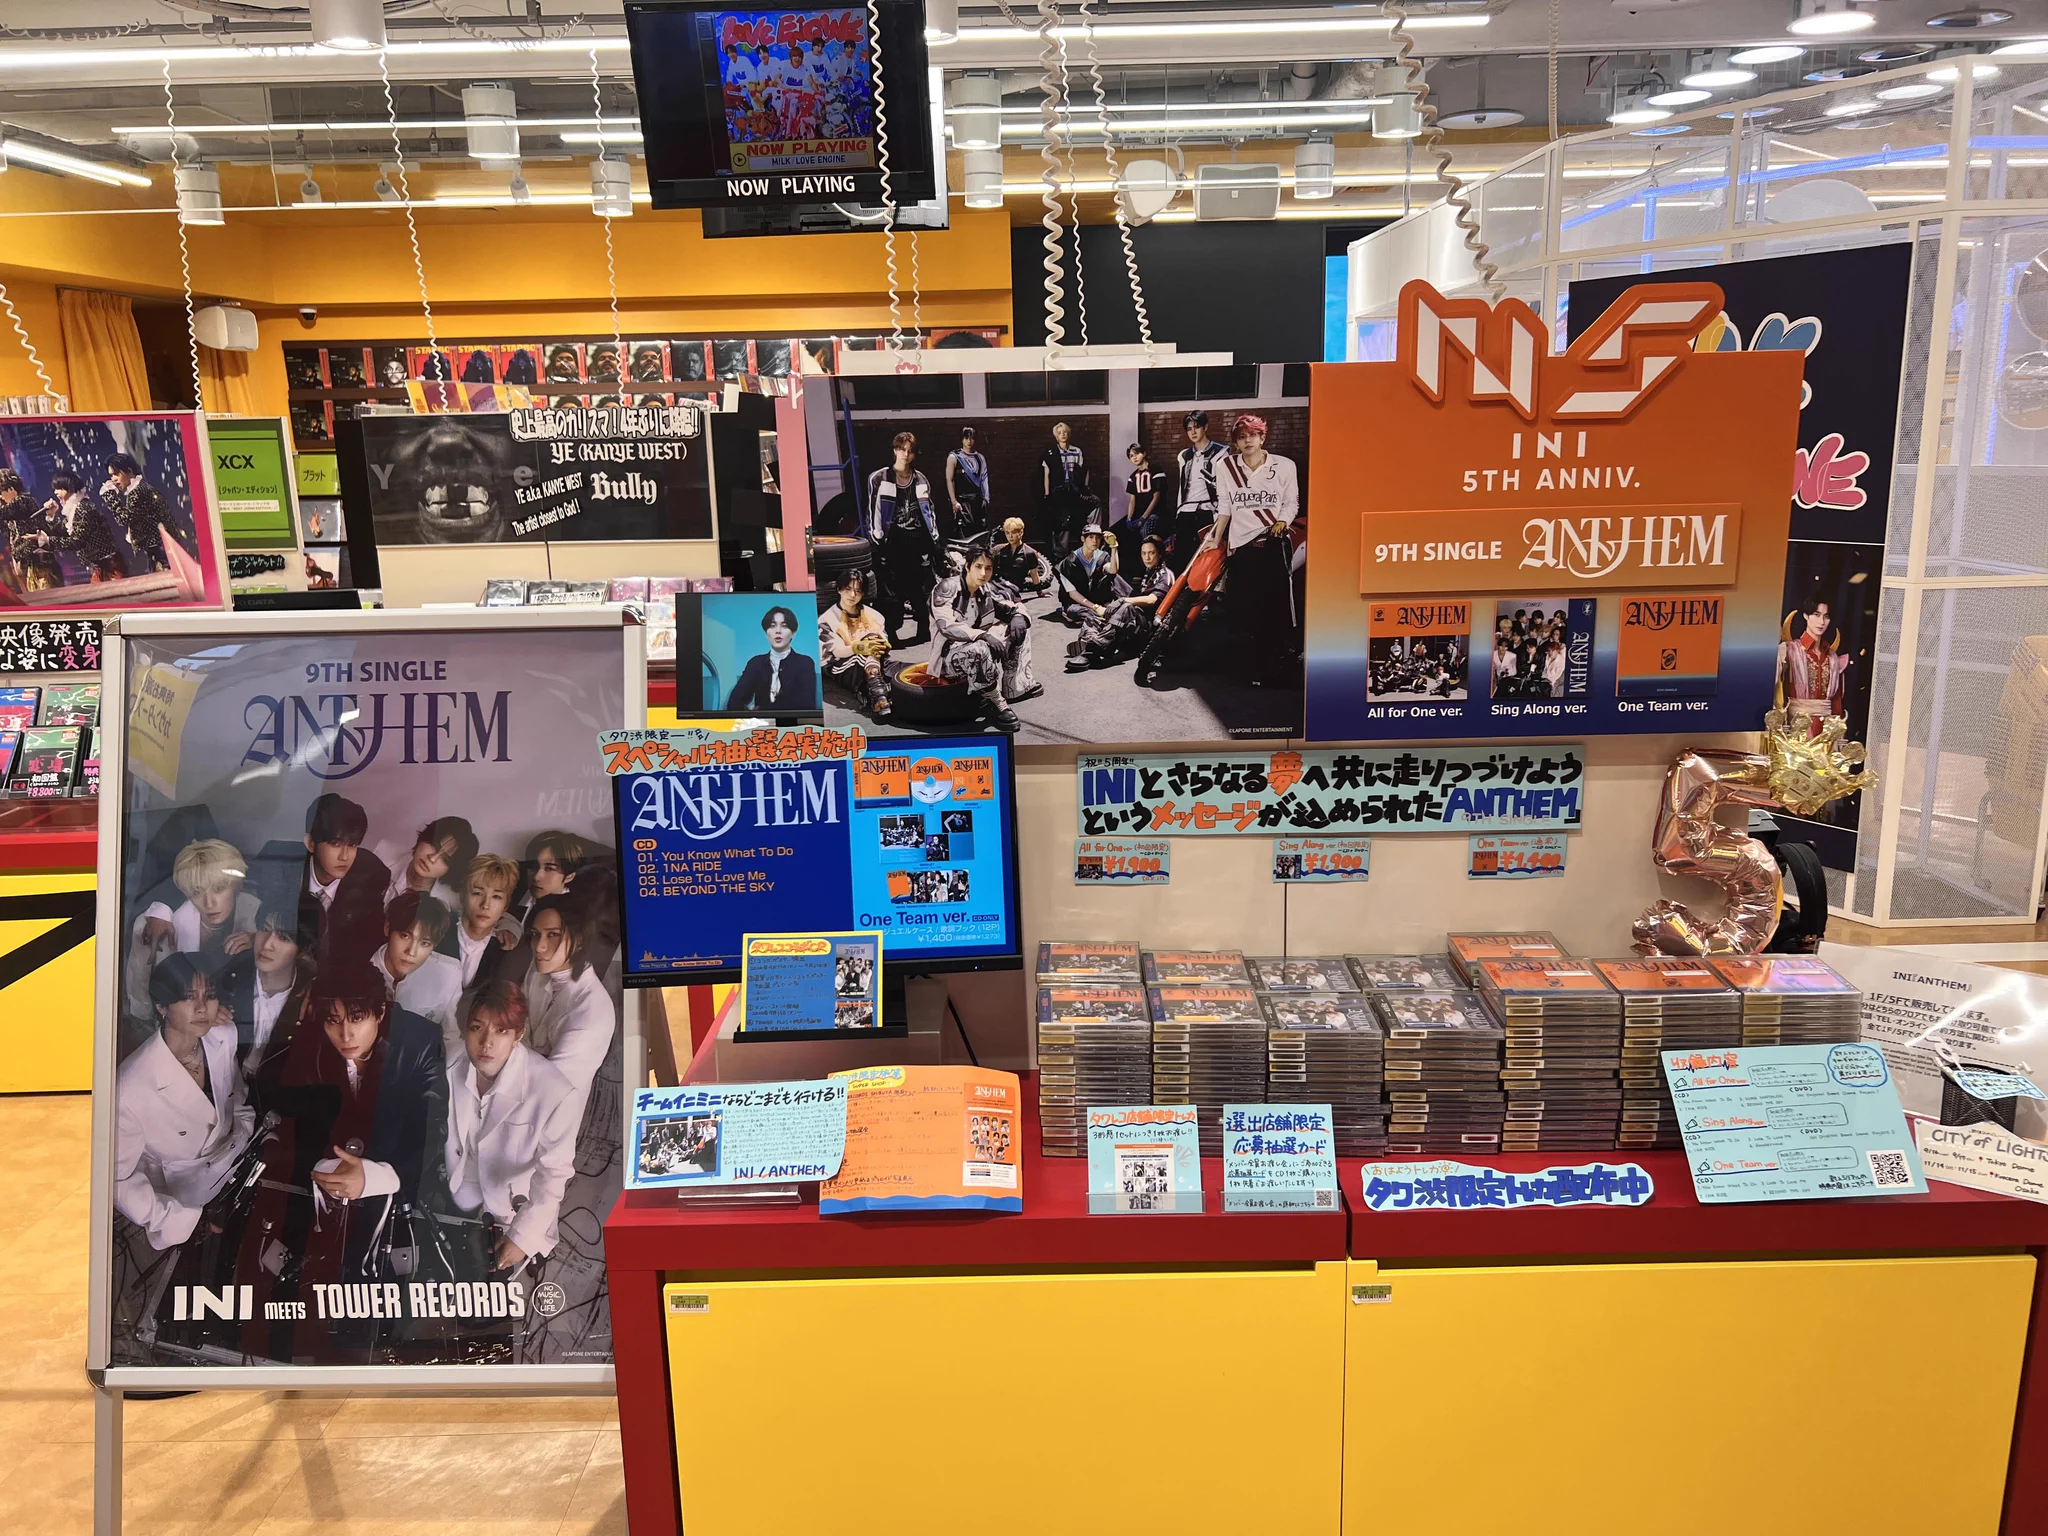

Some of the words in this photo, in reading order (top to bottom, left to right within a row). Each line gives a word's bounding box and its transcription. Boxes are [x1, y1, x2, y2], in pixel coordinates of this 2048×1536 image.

[746, 143, 785, 156] NOW
[792, 140, 867, 154] PLAYING
[795, 156, 815, 165] LOVE
[817, 155, 846, 164] ENGINE
[727, 178, 769, 197] NOW
[781, 175, 856, 195] PLAYING
[551, 442, 576, 465] YE
[578, 443, 637, 463] (KANYE
[638, 441, 688, 461] WEST)
[1512, 431, 1587, 459] INI
[218, 455, 255, 469] XCX
[370, 464, 395, 490] Y
[513, 465, 534, 487] e
[542, 476, 566, 497] KANYE
[565, 472, 584, 491] WEST
[1135, 472, 1151, 493] 10
[1463, 468, 1521, 492] 5TH
[1535, 465, 1640, 491] ANNIV.
[590, 471, 658, 504] Bully
[512, 519, 525, 536] The
[525, 514, 539, 532] artist
[538, 506, 558, 528] closest
[564, 500, 576, 518] God
[1374, 542, 1418, 562] 9TH
[1422, 540, 1503, 561] SINGLE
[1518, 514, 1728, 579] ANTHEM
[1396, 604, 1467, 629] ANTHEM
[1624, 600, 1719, 631] ANTHEM
[1568, 631, 1591, 693] ANTHEM
[305, 662, 353, 683] 9TH
[360, 660, 447, 682] SINGLE
[1367, 706, 1385, 718] All
[1387, 705, 1408, 718] for
[1410, 706, 1437, 718] One
[1438, 707, 1463, 717] ver.
[1490, 704, 1523, 719] Sing
[1526, 703, 1560, 718] Along
[1564, 705, 1587, 715] ver.
[1618, 701, 1644, 713] One
[1647, 701, 1683, 713] Team
[1687, 701, 1709, 711] ver.
[240, 690, 513, 780] ANTHEM
[603, 727, 867, 774] スペシャル抽選会実施中
[861, 758, 907, 775] ANTHEM
[915, 765, 944, 775] ANTHEM
[954, 759, 989, 776] ANTHEM
[1082, 752, 1583, 806] INIとさらなる夢へ共に走りつづけよう
[630, 768, 841, 840] ANTHEM
[1082, 783, 1581, 835] というメッセージが込められた「ANTHEM」
[636, 841, 654, 849] CD
[1079, 843, 1091, 854] All
[1094, 843, 1106, 851] for
[1107, 843, 1123, 852] One
[1279, 840, 1299, 851] Sing
[1302, 838, 1324, 850] Along
[1477, 838, 1495, 848] One
[637, 852, 659, 862] 01.
[661, 851, 685, 861] You
[687, 850, 721, 860] Know
[724, 848, 756, 858] What
[759, 847, 774, 856] To
[776, 846, 794, 856] Do
[638, 864, 659, 874] 02.
[663, 863, 690, 873] 1NA
[693, 861, 722, 871] RIDE
[638, 876, 659, 886] 03.
[662, 875, 692, 885] Lose
[695, 873, 712, 883] To
[715, 872, 745, 882] Love
[748, 871, 766, 880] Me
[639, 887, 660, 897] 04.
[663, 884, 717, 896] BEYOND
[720, 883, 747, 893] THE
[749, 882, 775, 892] SKY
[859, 913, 892, 926] One
[896, 911, 939, 925] Team
[943, 912, 970, 923] ver.
[978, 923, 1000, 932] (12P)
[917, 933, 953, 943] ¥1,400
[1692, 1077, 1703, 1085] All
[1705, 1077, 1717, 1085] for
[1719, 1076, 1736, 1084] One
[637, 1087, 845, 1112] チームイニミニならどこまでも行ける!!
[1225, 1111, 1326, 1132] 選出店舗限定
[1702, 1118, 1725, 1127] Sing
[1728, 1117, 1753, 1127] Along
[1233, 1135, 1327, 1155] 応募抽選カード
[1931, 1129, 1972, 1145] CITY
[1973, 1136, 1992, 1148] of
[734, 1165, 755, 1179] INI
[768, 1164, 827, 1177] ANTHEM
[1713, 1160, 1734, 1170] One
[1737, 1159, 1763, 1169] Team
[2012, 1162, 2035, 1173] Dome
[1365, 1165, 1650, 1209] タワ渋限定トレカ配布中
[173, 1284, 254, 1321] INI
[264, 1301, 306, 1320] MEETS
[312, 1282, 401, 1320] TOWER
[409, 1281, 526, 1319] RECORDS
